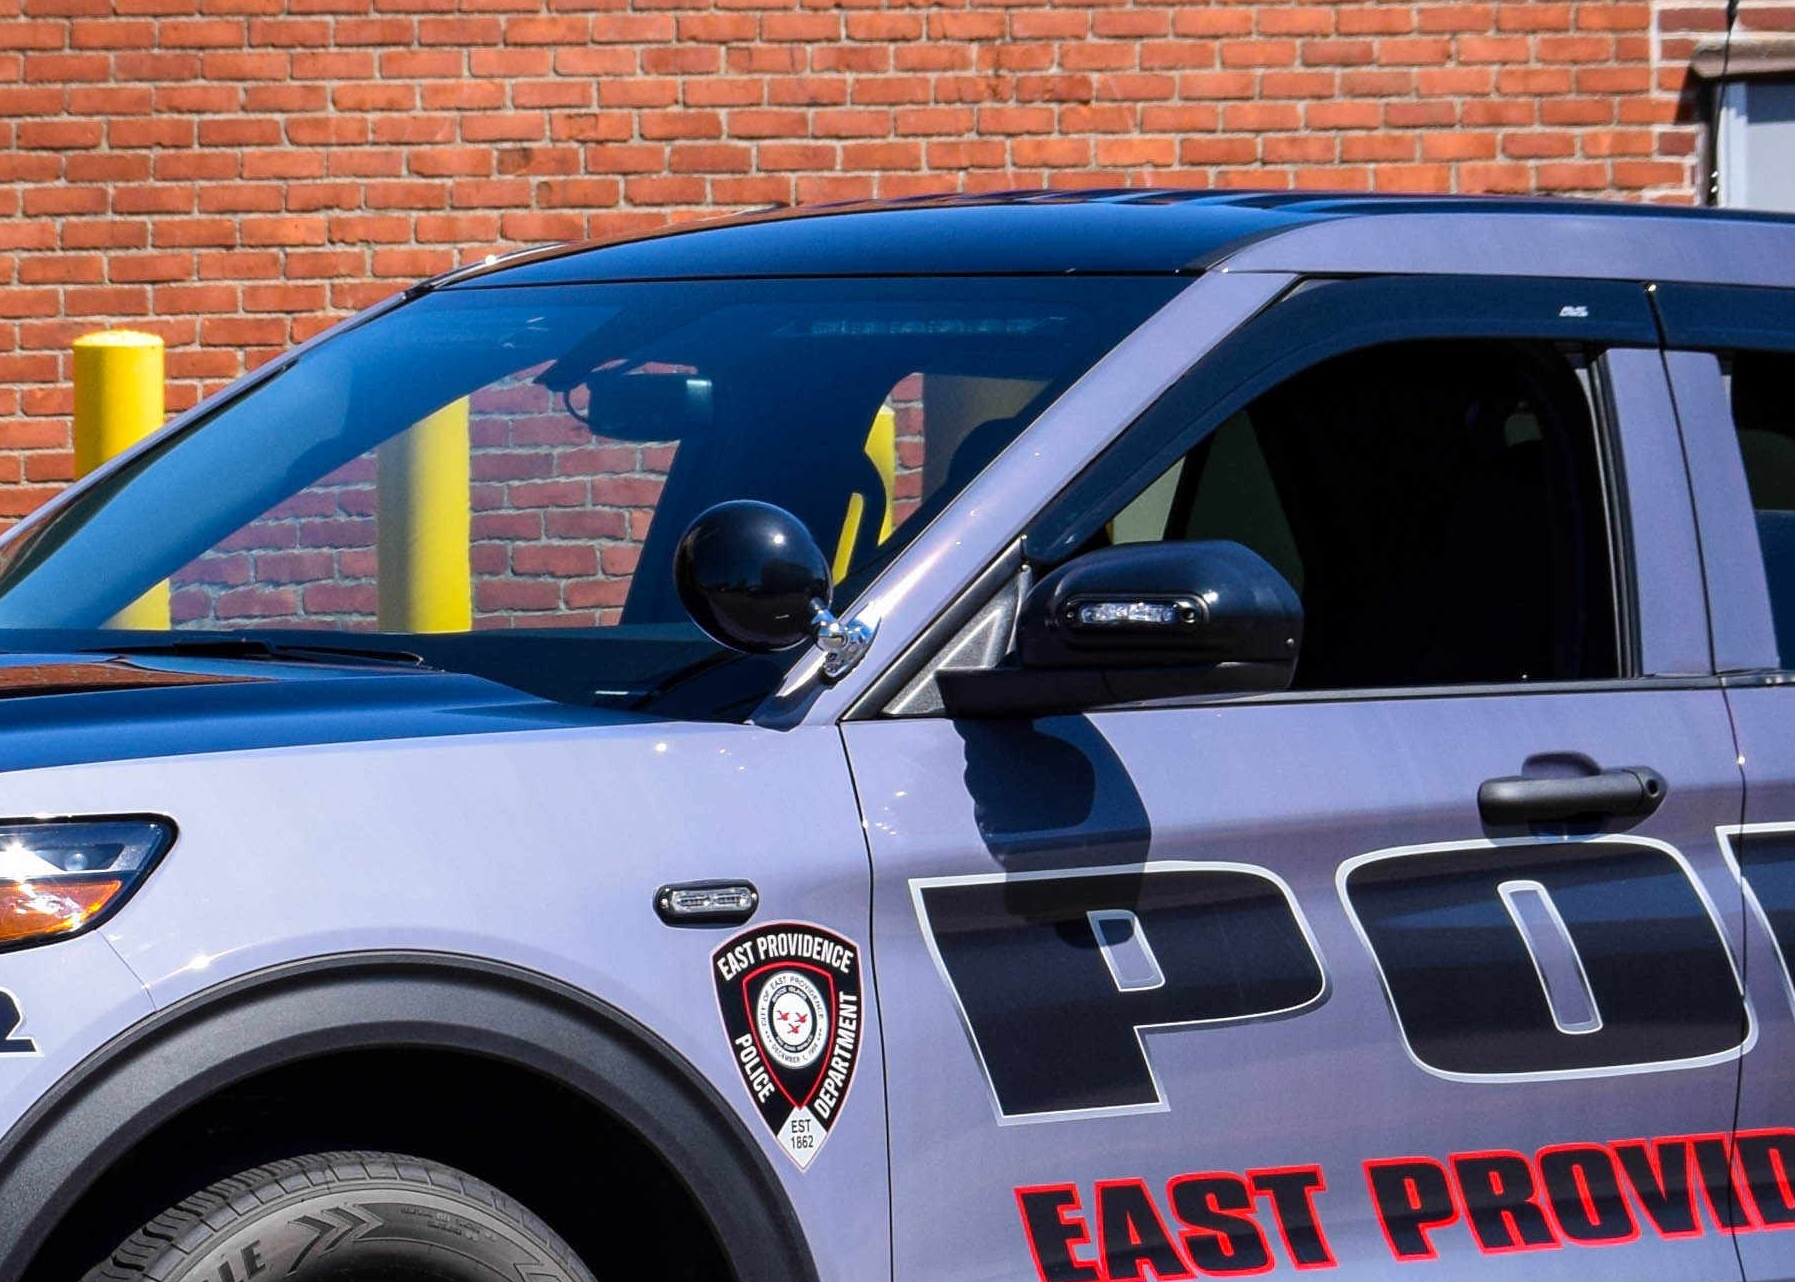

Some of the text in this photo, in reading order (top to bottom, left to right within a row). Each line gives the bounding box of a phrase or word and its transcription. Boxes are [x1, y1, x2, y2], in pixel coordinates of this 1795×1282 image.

[717, 933, 854, 981] EAST PROVIDENCE
[735, 1033, 776, 1104] POLICE
[813, 991, 858, 1120] DEPARTMENT
[790, 1135, 814, 1150] 1862
[791, 1119, 812, 1134] EST
